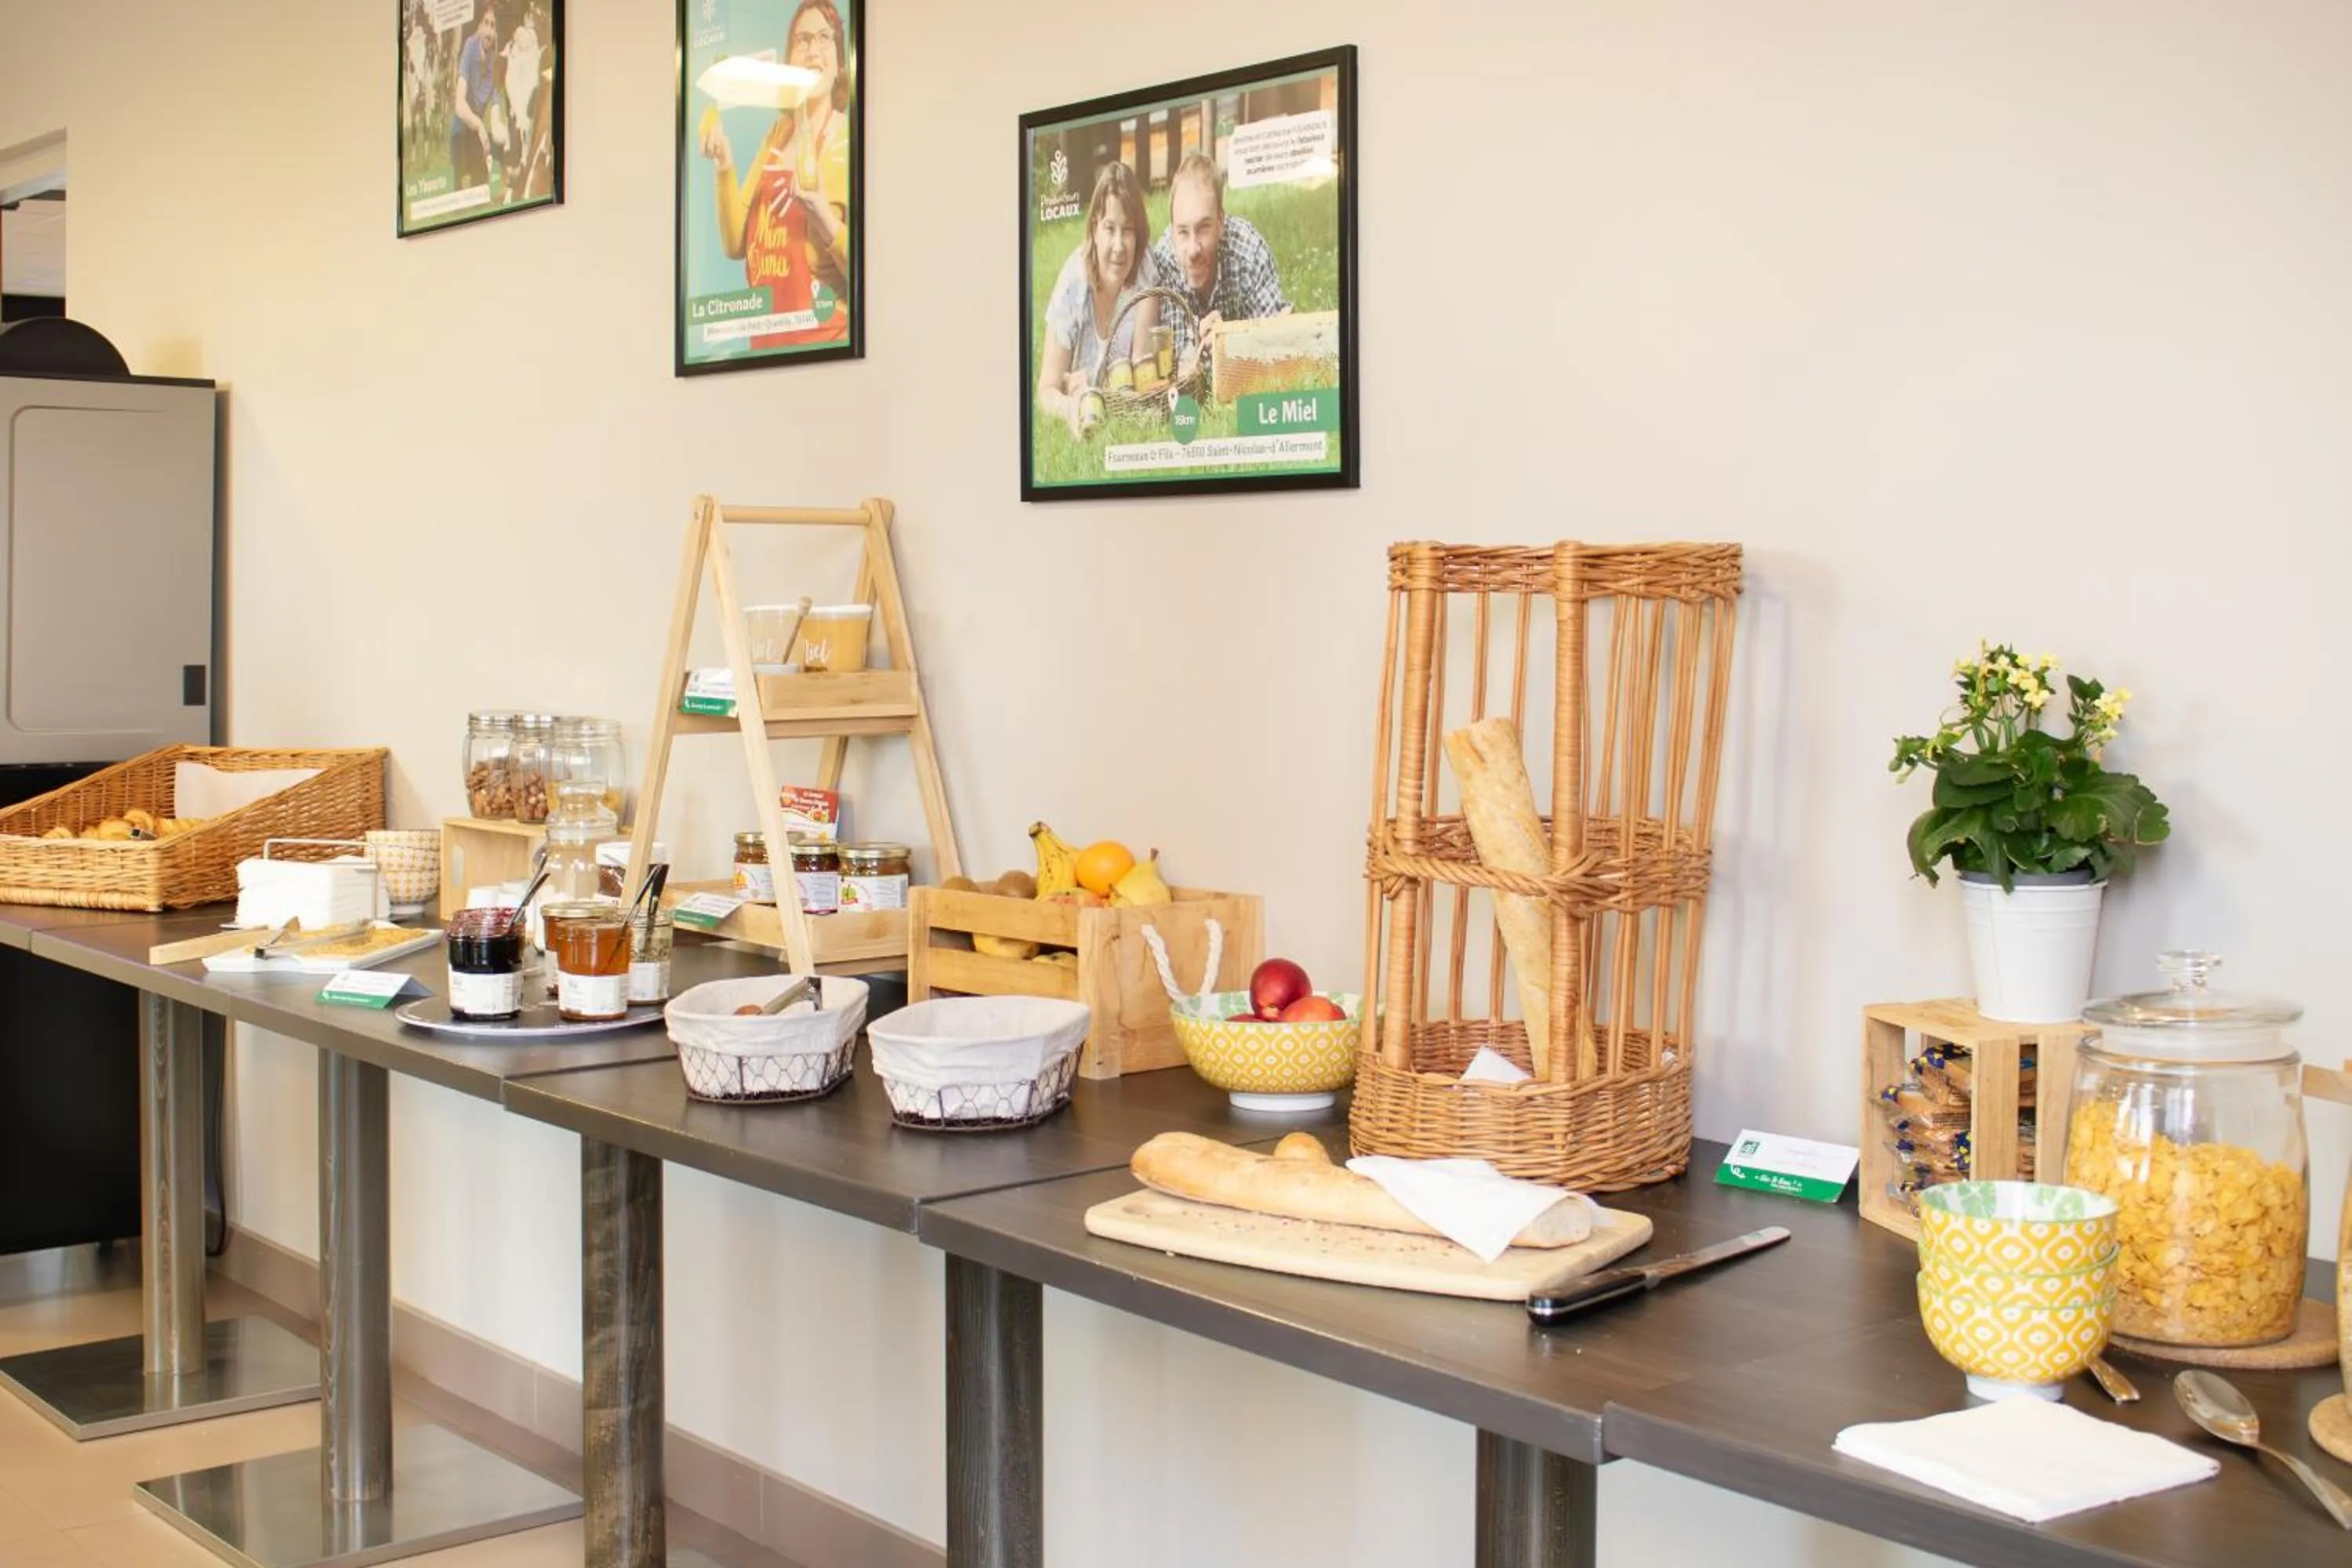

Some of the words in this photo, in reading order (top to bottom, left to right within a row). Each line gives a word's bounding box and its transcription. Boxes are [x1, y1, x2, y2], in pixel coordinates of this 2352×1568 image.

[1040, 203, 1080, 222] LOCAUX
[692, 303, 705, 318] La
[708, 292, 764, 315] Citronade
[1258, 402, 1278, 425] Le
[1282, 397, 1318, 424] Miel
